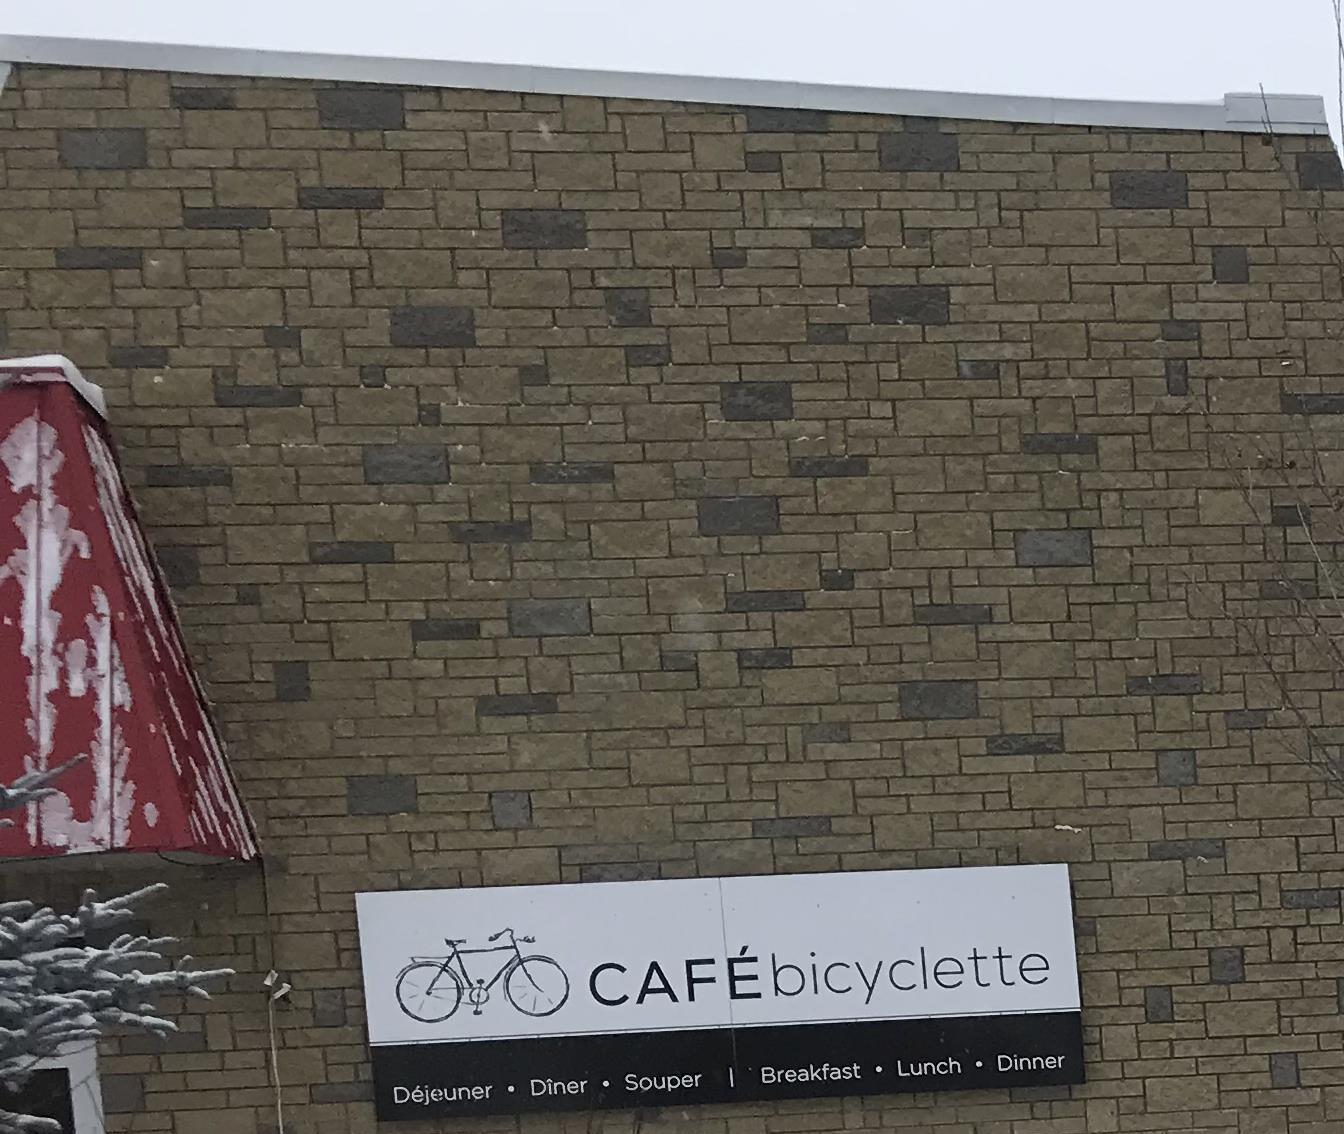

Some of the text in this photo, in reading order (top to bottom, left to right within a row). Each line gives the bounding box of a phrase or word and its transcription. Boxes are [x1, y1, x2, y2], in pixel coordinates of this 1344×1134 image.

[393, 1054, 1065, 1105] Déjeuner Dîner Souper Breakfast Lunch Dinner
